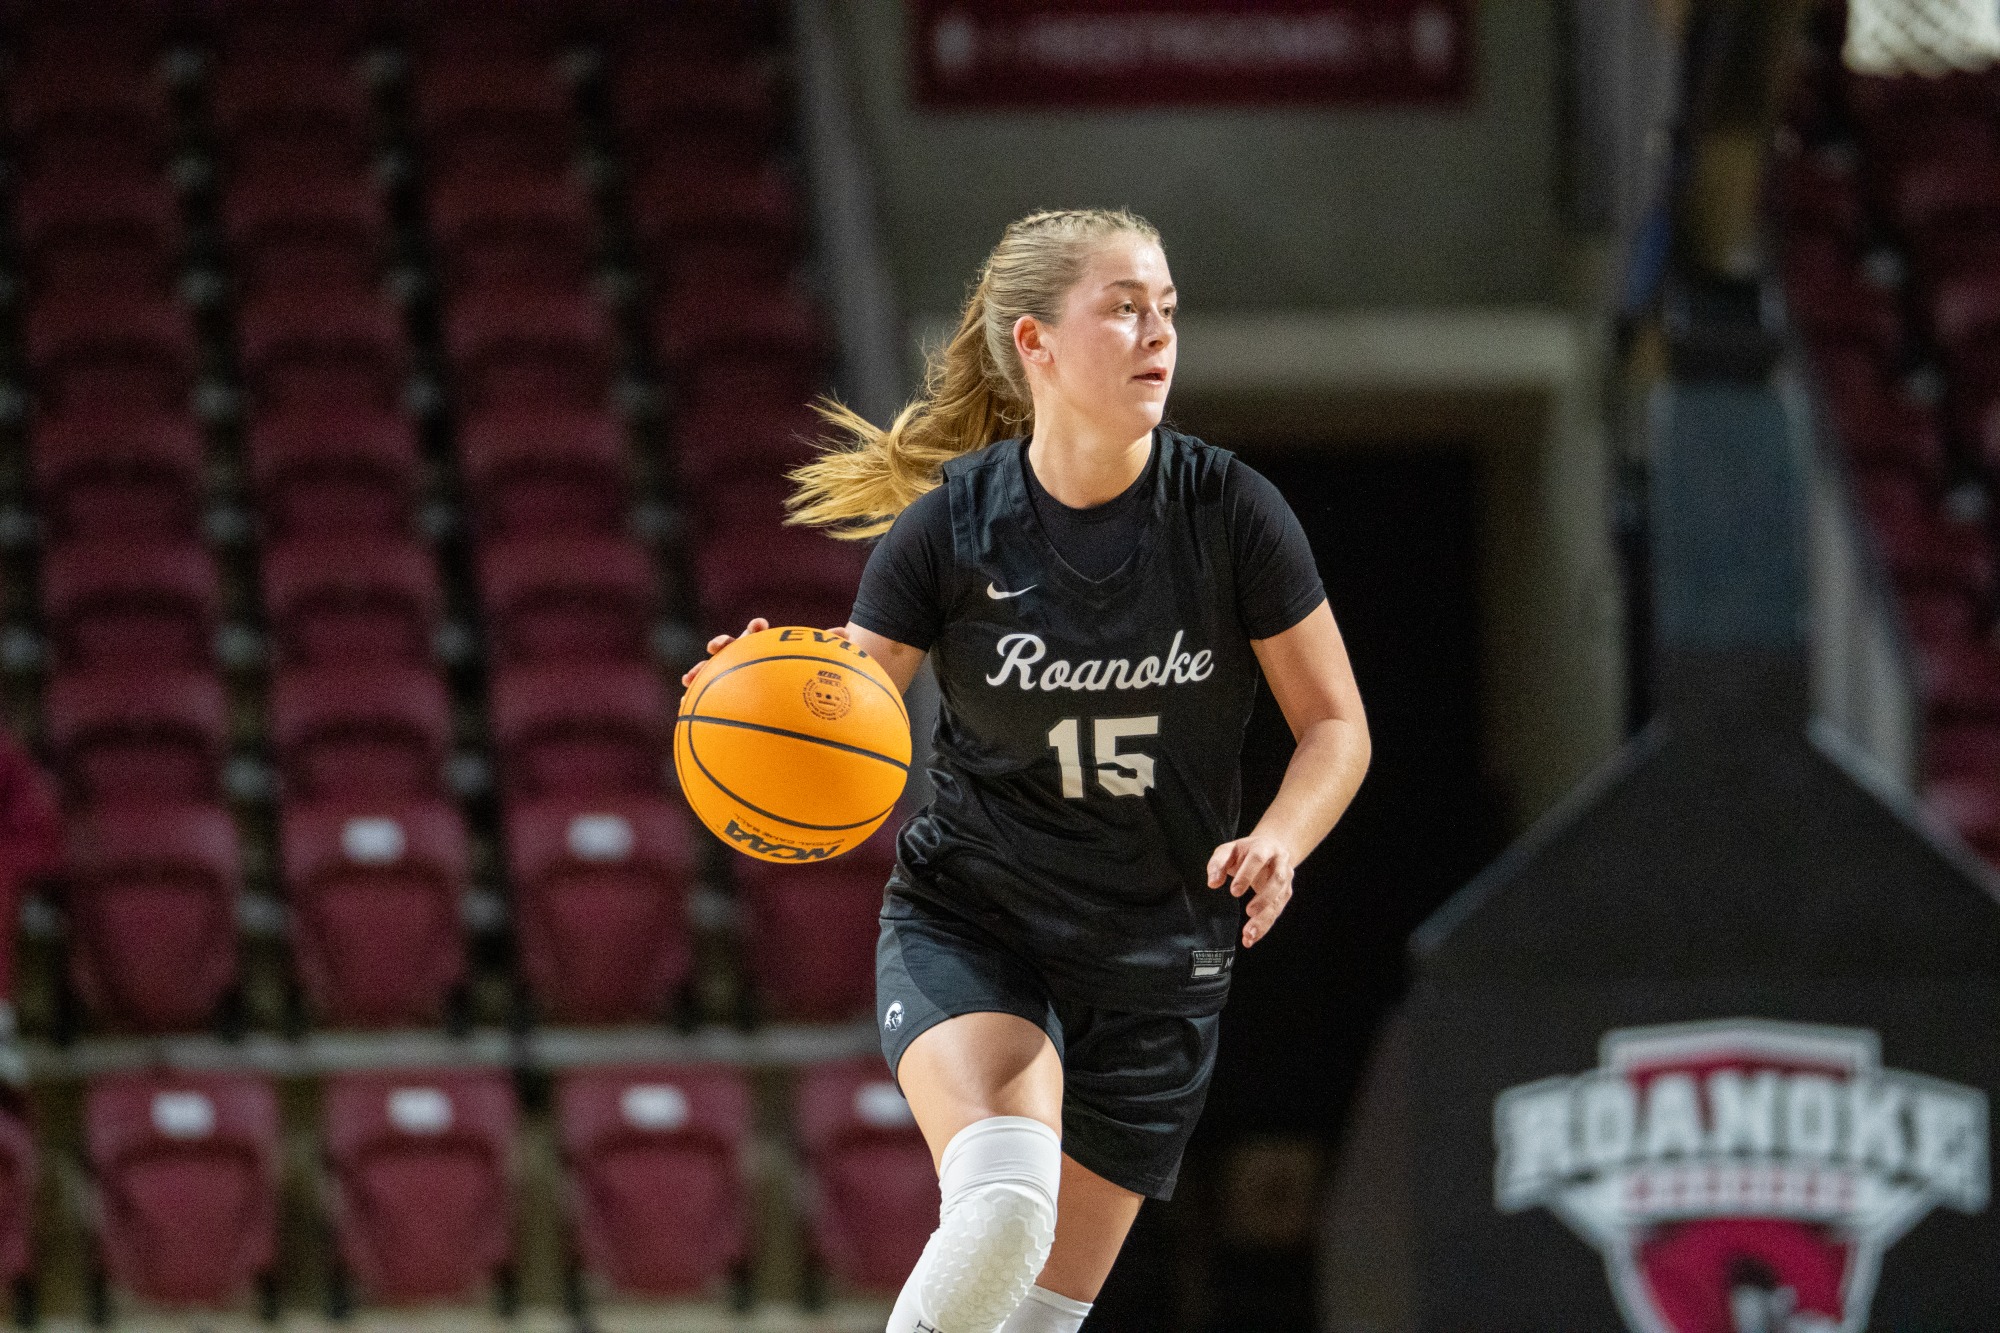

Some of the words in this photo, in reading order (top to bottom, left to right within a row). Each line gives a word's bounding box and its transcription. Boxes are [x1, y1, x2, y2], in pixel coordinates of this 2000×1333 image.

[986, 629, 1215, 692] Roanoke
[1048, 715, 1159, 799] 15
[724, 819, 842, 861] NCAA
